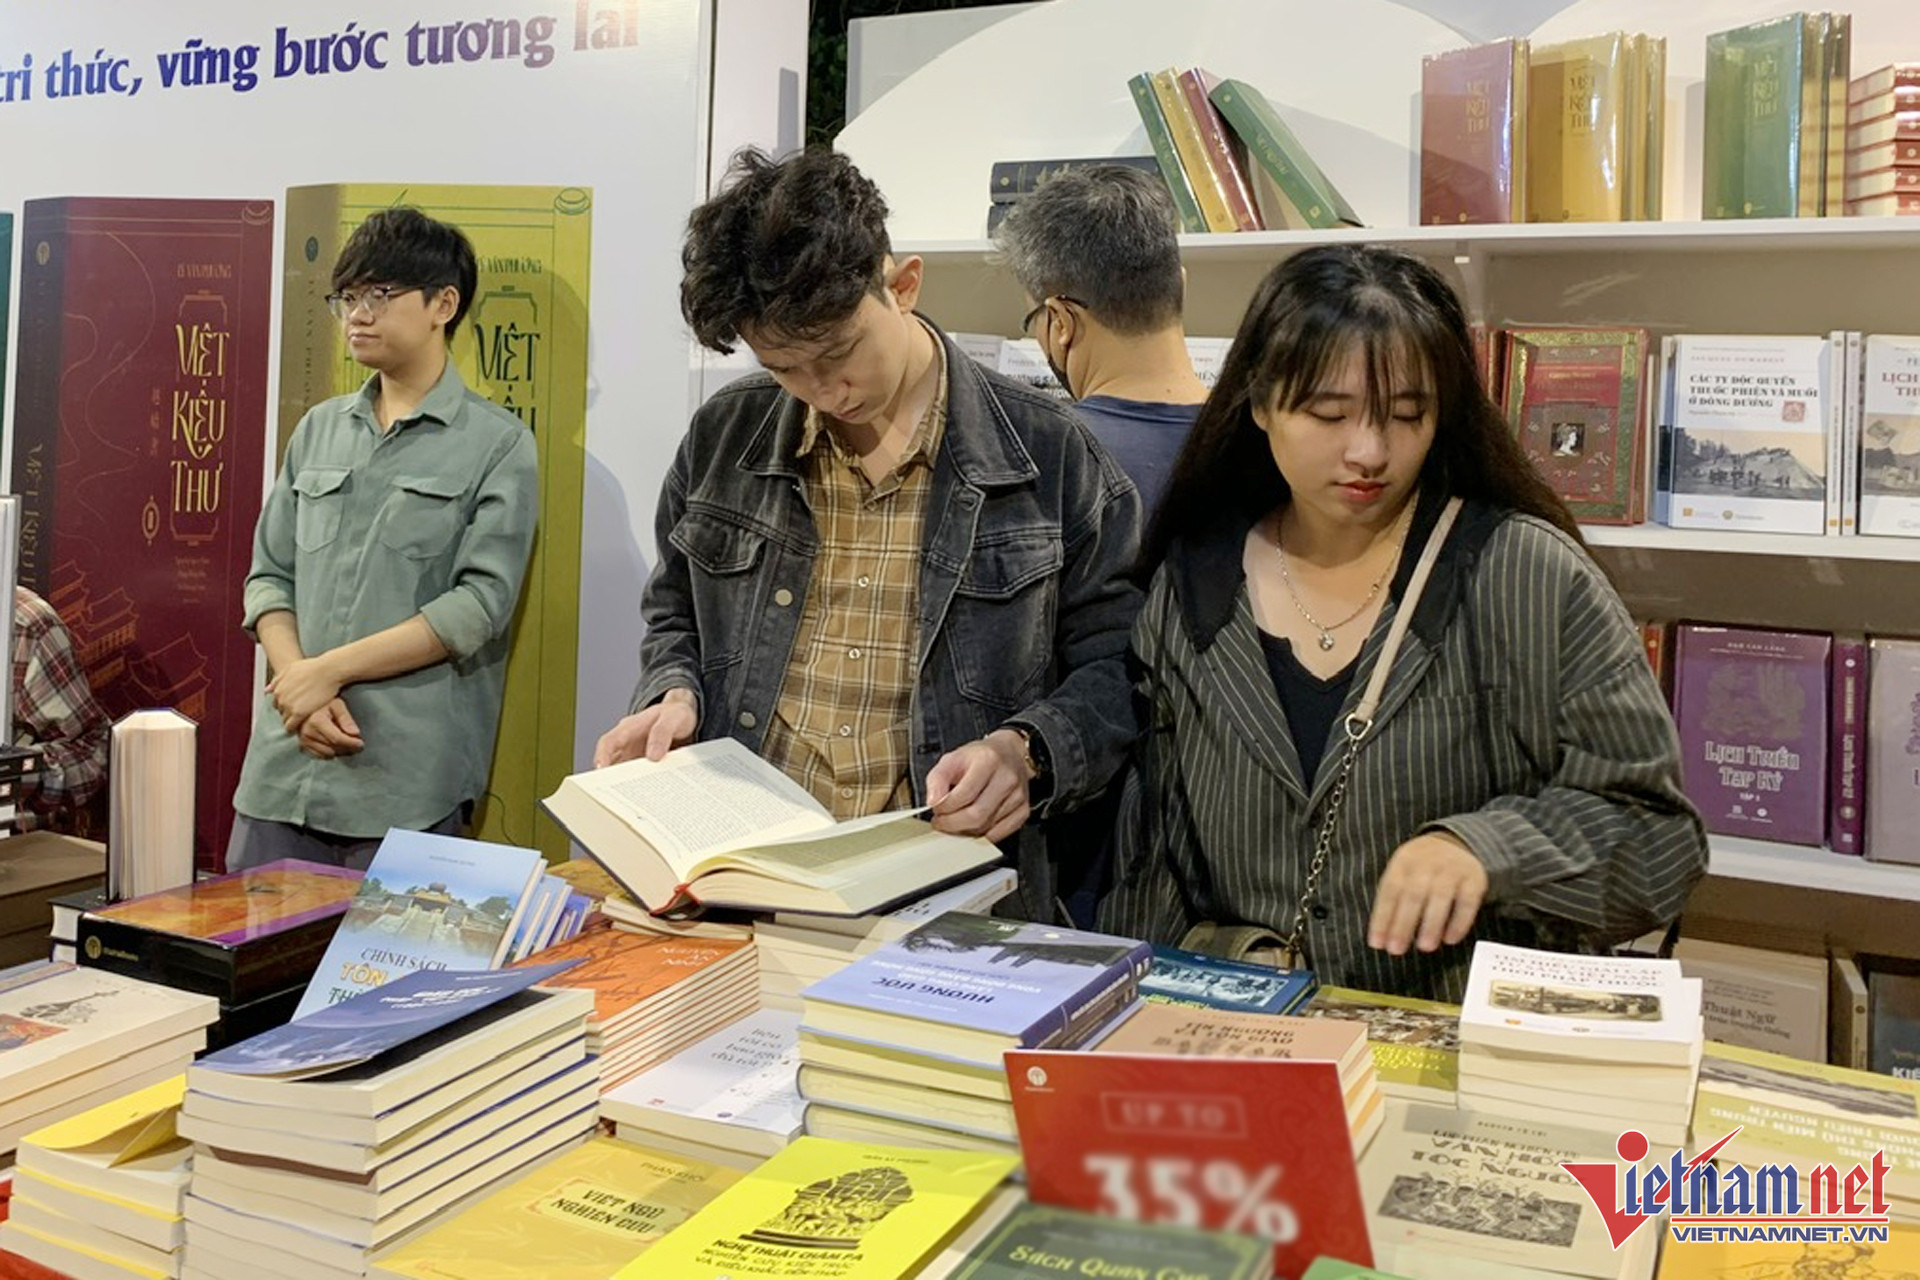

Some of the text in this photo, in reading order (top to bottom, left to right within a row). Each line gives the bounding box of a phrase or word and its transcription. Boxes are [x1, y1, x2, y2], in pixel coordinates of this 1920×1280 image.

[45, 49, 143, 98] thức,
[157, 39, 259, 92] vững
[274, 22, 389, 78] bước
[404, 16, 557, 68] tương
[175, 322, 230, 387] VIỆT
[474, 322, 541, 392] VIỆT
[171, 390, 226, 460] KIỆU
[170, 460, 225, 513] THƯ
[339, 959, 388, 987] TÔN
[360, 946, 406, 969] CHÍNH
[1083, 1154, 1301, 1244] 35%
